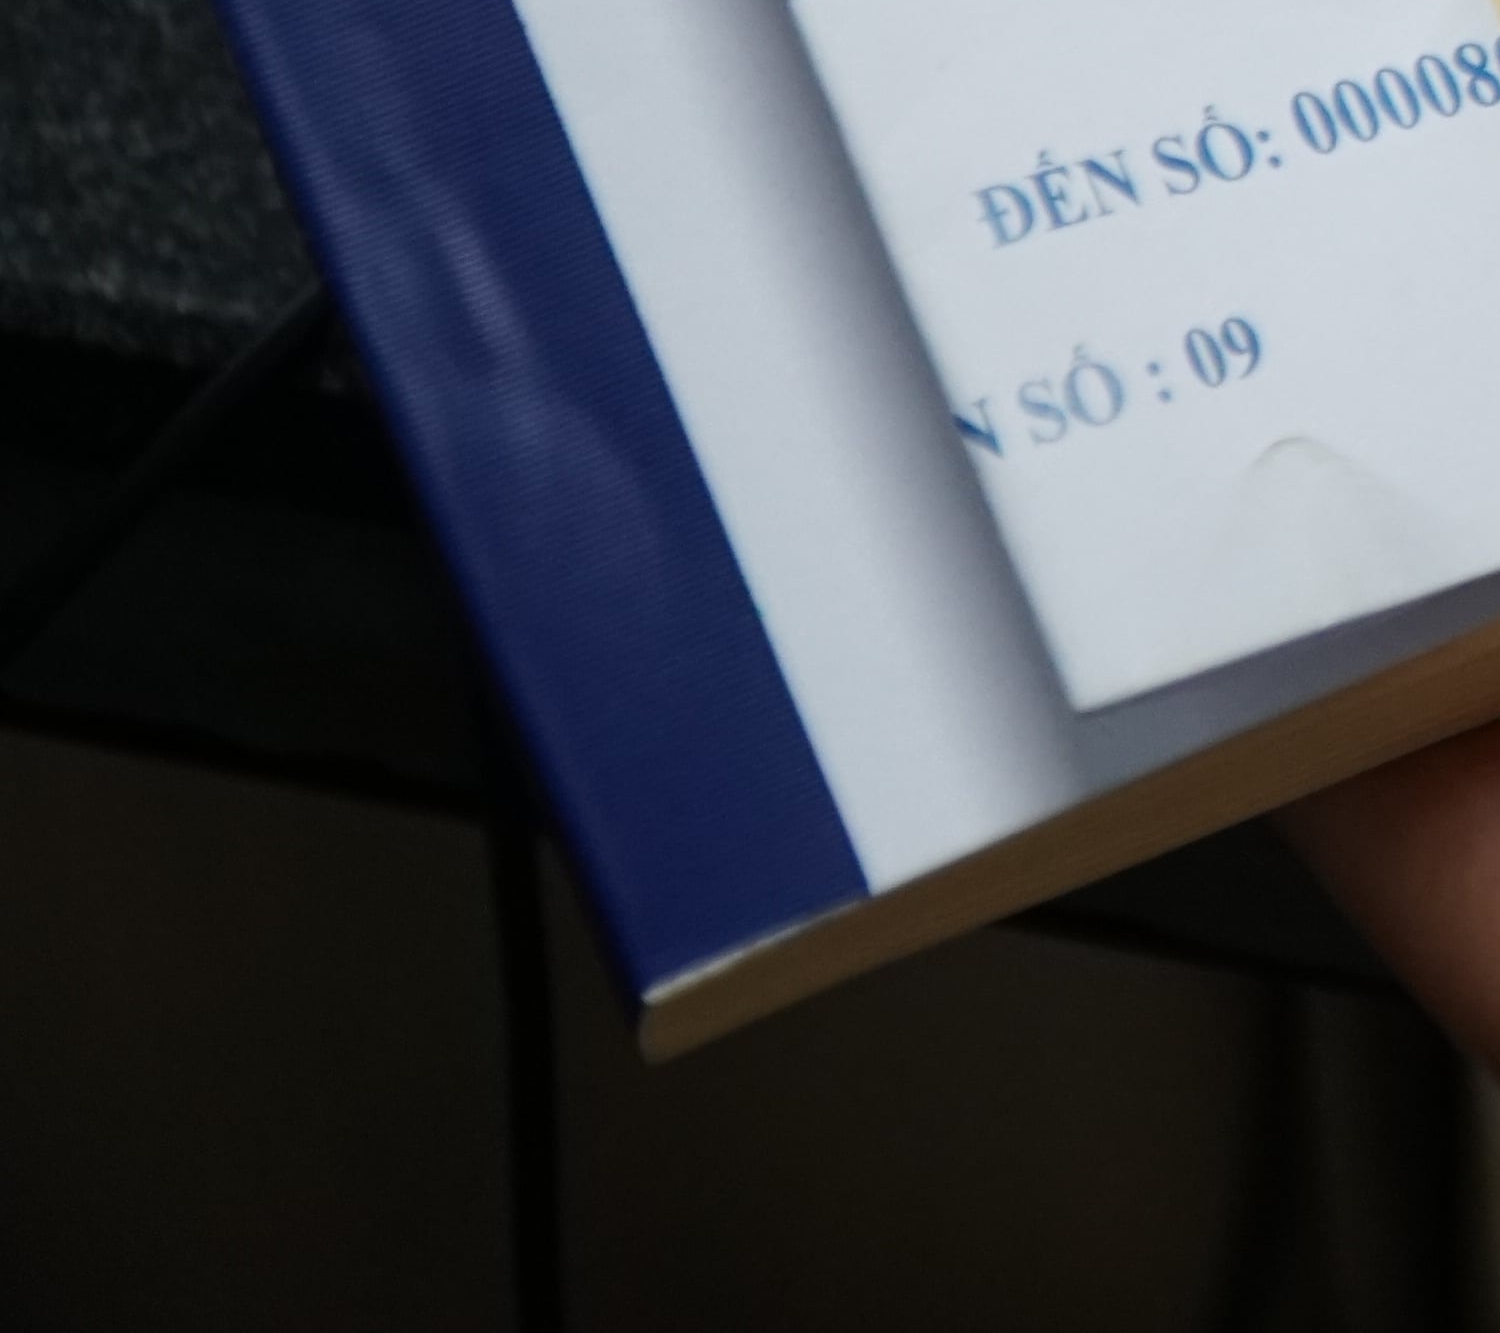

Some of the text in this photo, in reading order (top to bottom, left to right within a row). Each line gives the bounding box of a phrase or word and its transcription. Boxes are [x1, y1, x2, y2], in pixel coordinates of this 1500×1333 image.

[978, 149, 1139, 245] ĐẾN
[1149, 106, 1282, 194] SỐ:
[1017, 316, 1263, 444] SỐ 09
